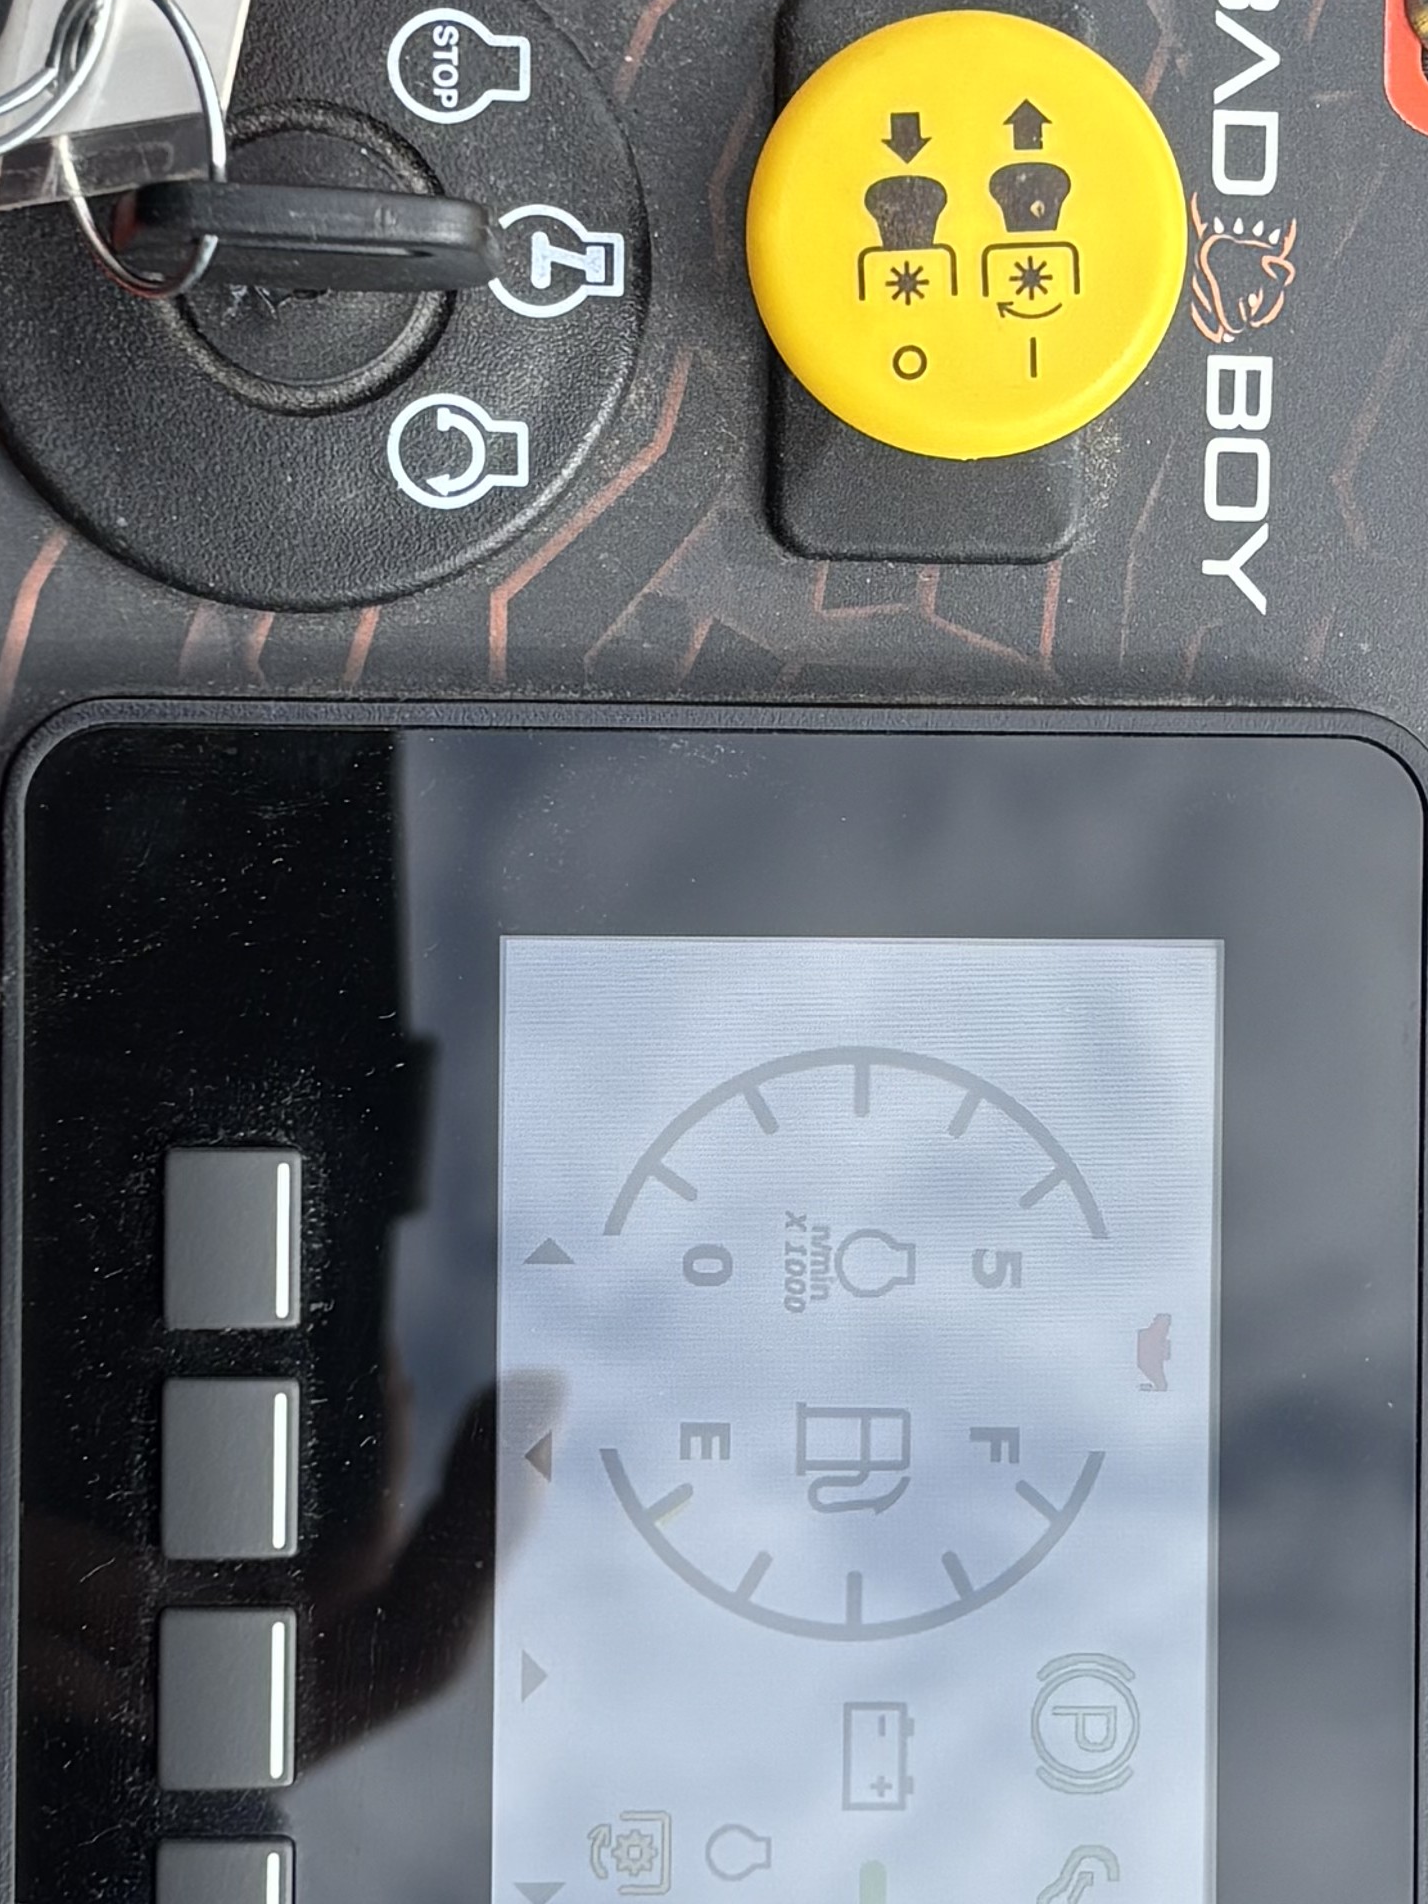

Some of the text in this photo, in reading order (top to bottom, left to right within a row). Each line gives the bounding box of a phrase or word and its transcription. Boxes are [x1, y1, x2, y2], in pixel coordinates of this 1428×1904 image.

[431, 24, 460, 110] STOP
[1200, 354, 1274, 616] BOY
[681, 1243, 734, 1287] 0
[782, 1242, 807, 1314] 1000
[810, 1224, 833, 1302] n/min
[972, 1248, 1022, 1289] 5
[679, 1421, 731, 1461] E
[970, 1426, 1020, 1464] F
